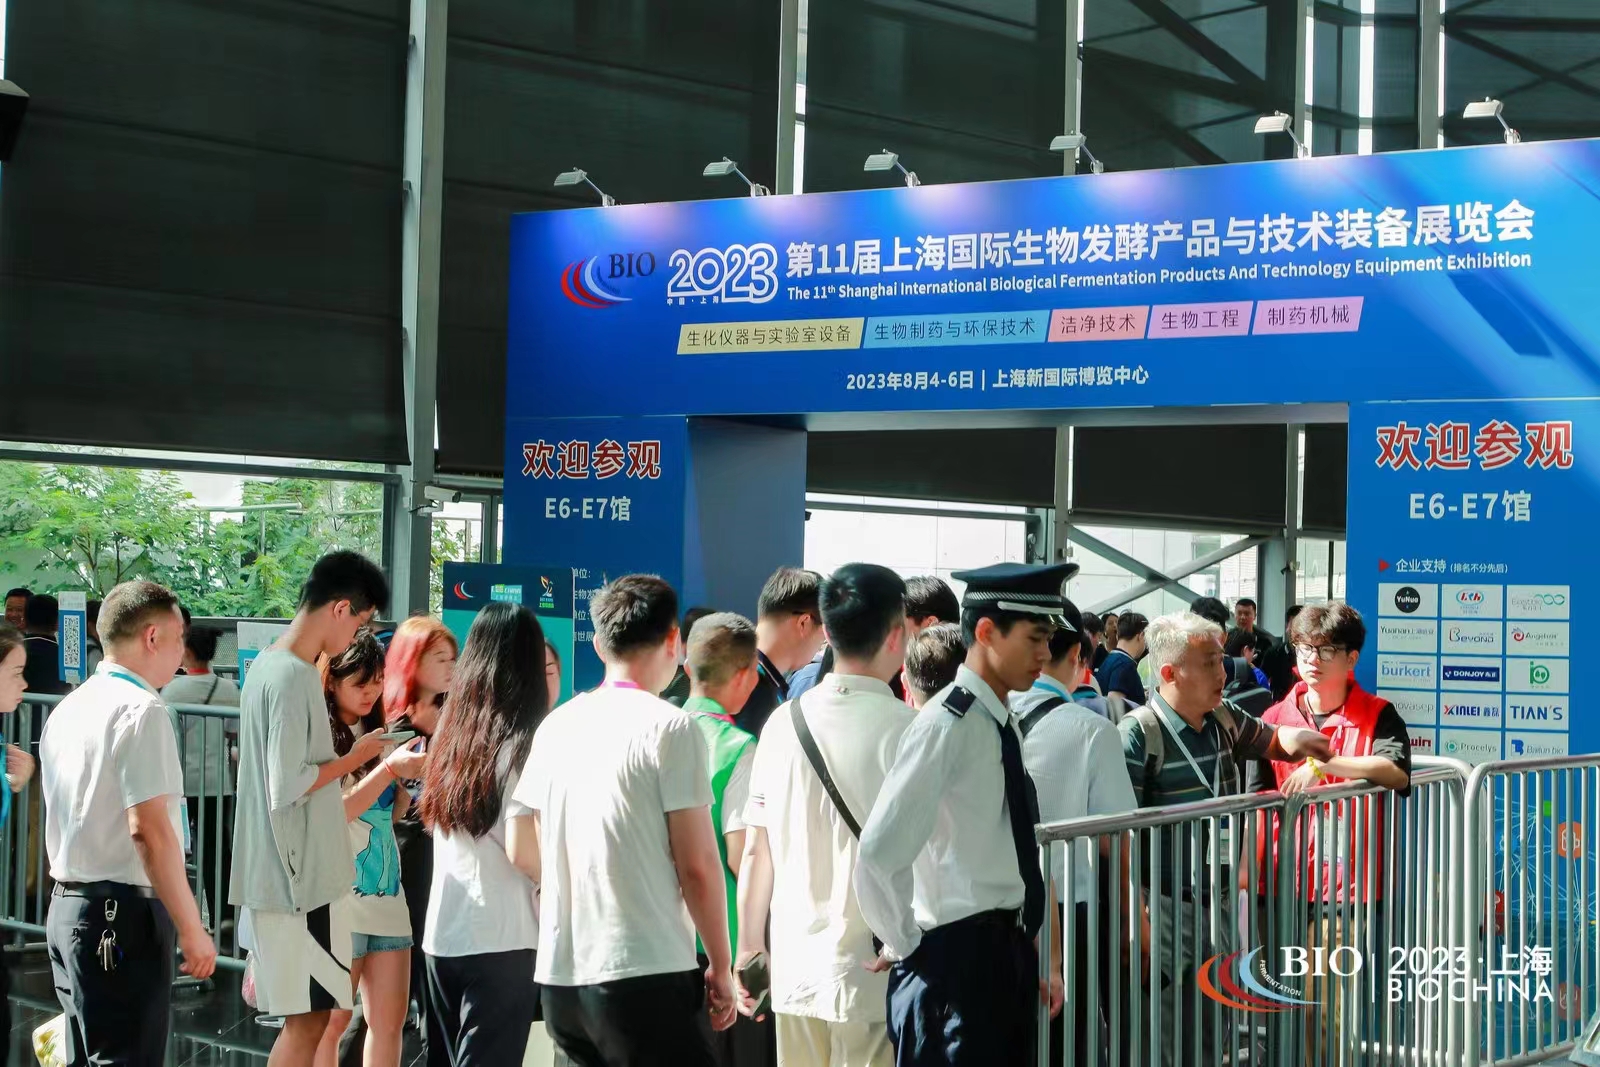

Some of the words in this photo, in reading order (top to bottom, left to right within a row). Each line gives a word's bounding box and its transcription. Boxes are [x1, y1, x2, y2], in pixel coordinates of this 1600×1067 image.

[785, 199, 1535, 279] 第11届上海国际生物发酵产品与技术装备展览会
[608, 251, 656, 279] BIO
[667, 243, 778, 304] 2023
[788, 287, 810, 300] The
[839, 282, 898, 300] Shanghai
[901, 277, 987, 295] International
[990, 274, 1056, 293] Biological
[1060, 269, 1157, 288] Fermentation
[1161, 266, 1226, 283] Products
[1229, 263, 1258, 280] And
[1262, 261, 1351, 278] Technology
[1355, 256, 1443, 276] Equipment
[1447, 251, 1532, 270] Exhibition
[1060, 312, 1137, 335] 洁净技术
[1161, 309, 1240, 331] 生物工程
[1266, 304, 1351, 327] 制药机械
[686, 325, 852, 347] 生化仪器与实验室设备
[874, 317, 1036, 341] 生物制药与环保技术
[846, 370, 974, 391] 2023年8月4-6日
[992, 365, 1150, 388] 上海新国际博览中心
[1375, 419, 1574, 471] 欢迎参观
[521, 438, 662, 480] 欢迎参观
[544, 495, 631, 521] E6-E7馆
[1408, 489, 1532, 522] E6-E7馆
[1395, 558, 1447, 573] 企业支持
[1510, 705, 1563, 721] TIAN'S
